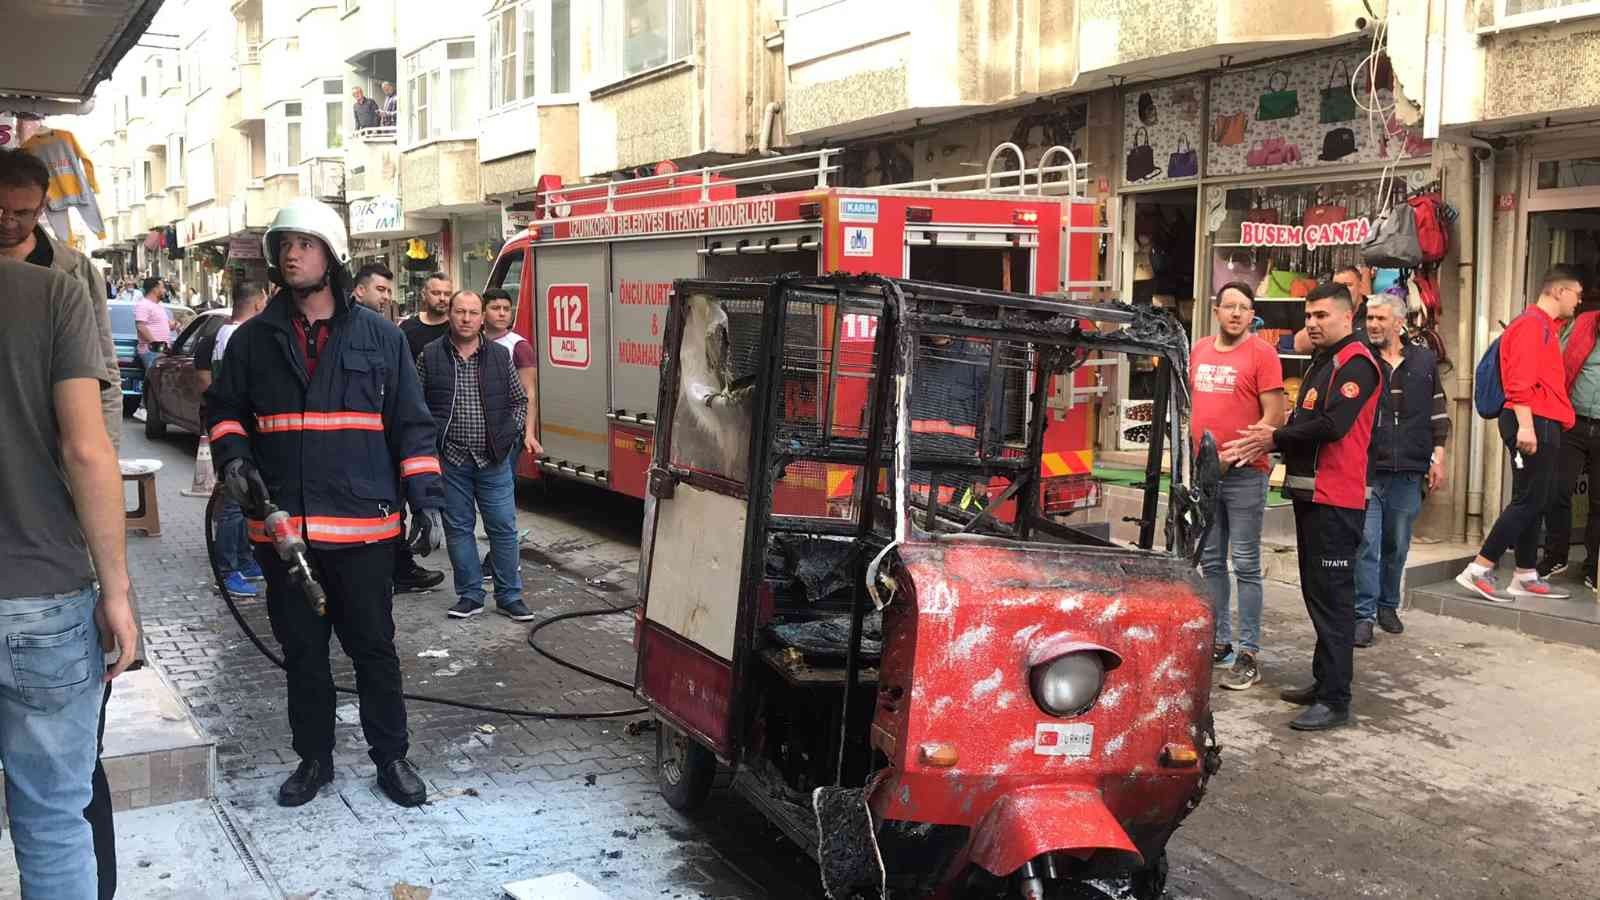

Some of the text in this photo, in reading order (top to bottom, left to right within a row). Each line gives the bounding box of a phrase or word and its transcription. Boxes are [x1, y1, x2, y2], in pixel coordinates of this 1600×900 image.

[1241, 218, 1370, 250] BUSEM ÇANTA
[645, 283, 672, 306] KURT
[553, 295, 583, 331] 112
